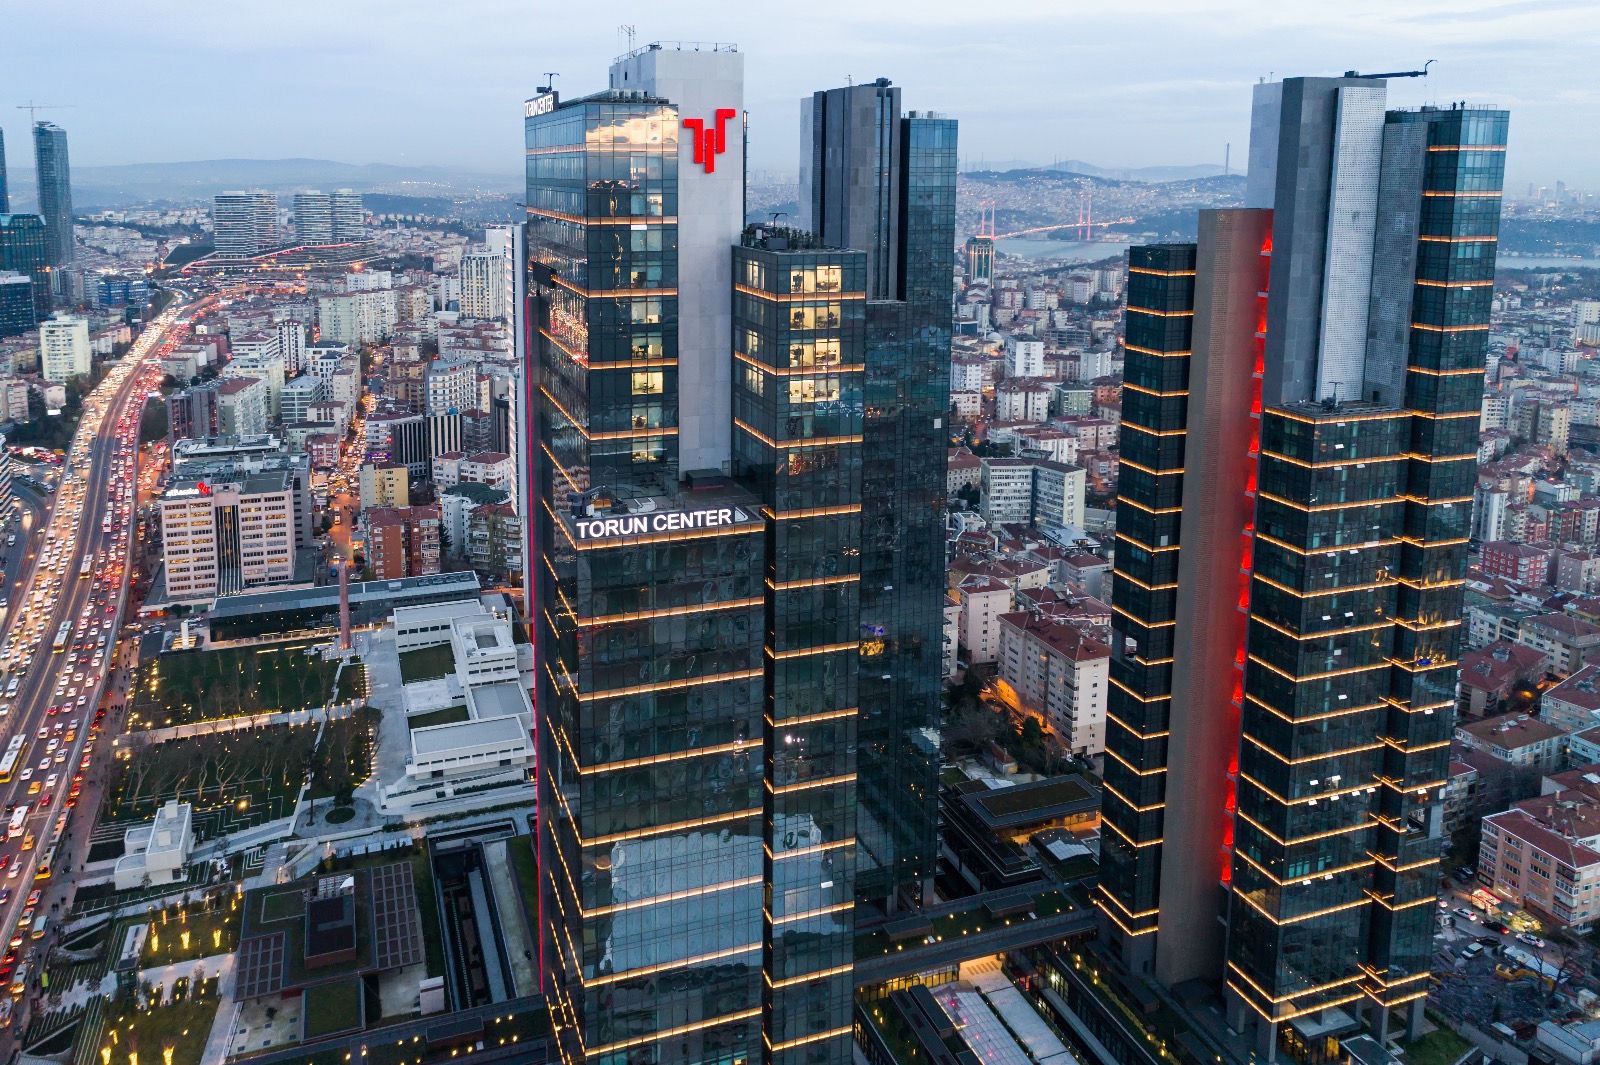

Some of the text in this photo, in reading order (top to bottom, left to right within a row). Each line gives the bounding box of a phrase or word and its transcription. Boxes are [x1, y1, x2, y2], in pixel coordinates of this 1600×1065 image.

[538, 94, 554, 115] CENTER
[577, 510, 732, 539] TORUN CENTER
